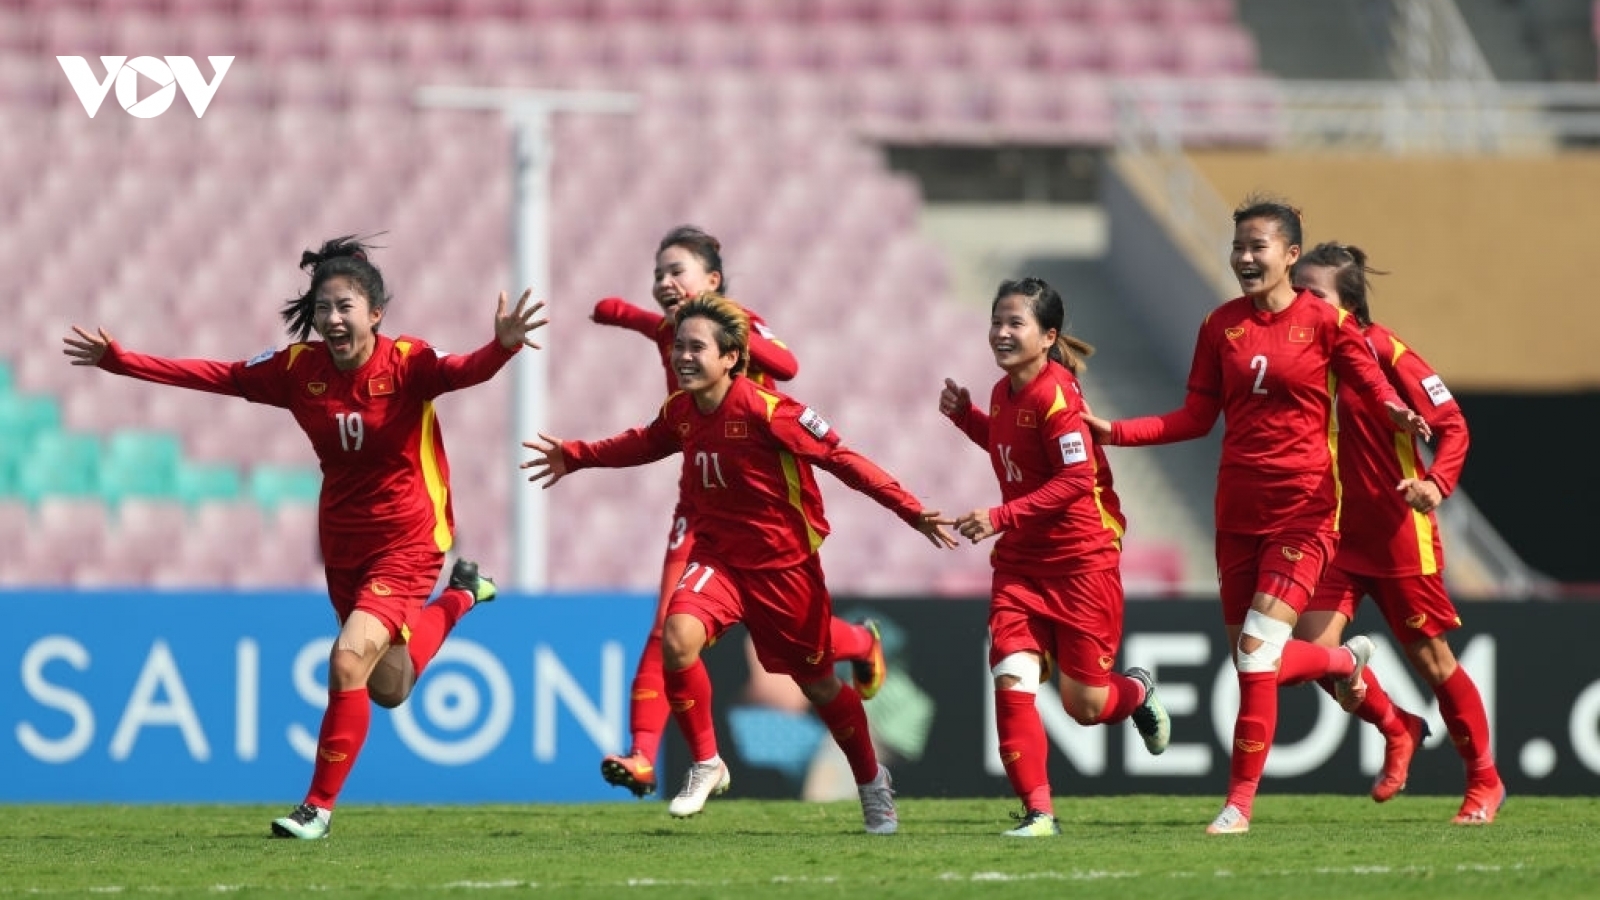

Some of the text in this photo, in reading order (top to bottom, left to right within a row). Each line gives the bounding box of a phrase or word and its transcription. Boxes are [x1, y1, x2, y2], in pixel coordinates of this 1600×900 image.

[1250, 355, 1268, 395] 2
[335, 412, 364, 451] 19
[695, 451, 727, 489] 21
[997, 444, 1023, 482] 16
[676, 561, 715, 594] 21
